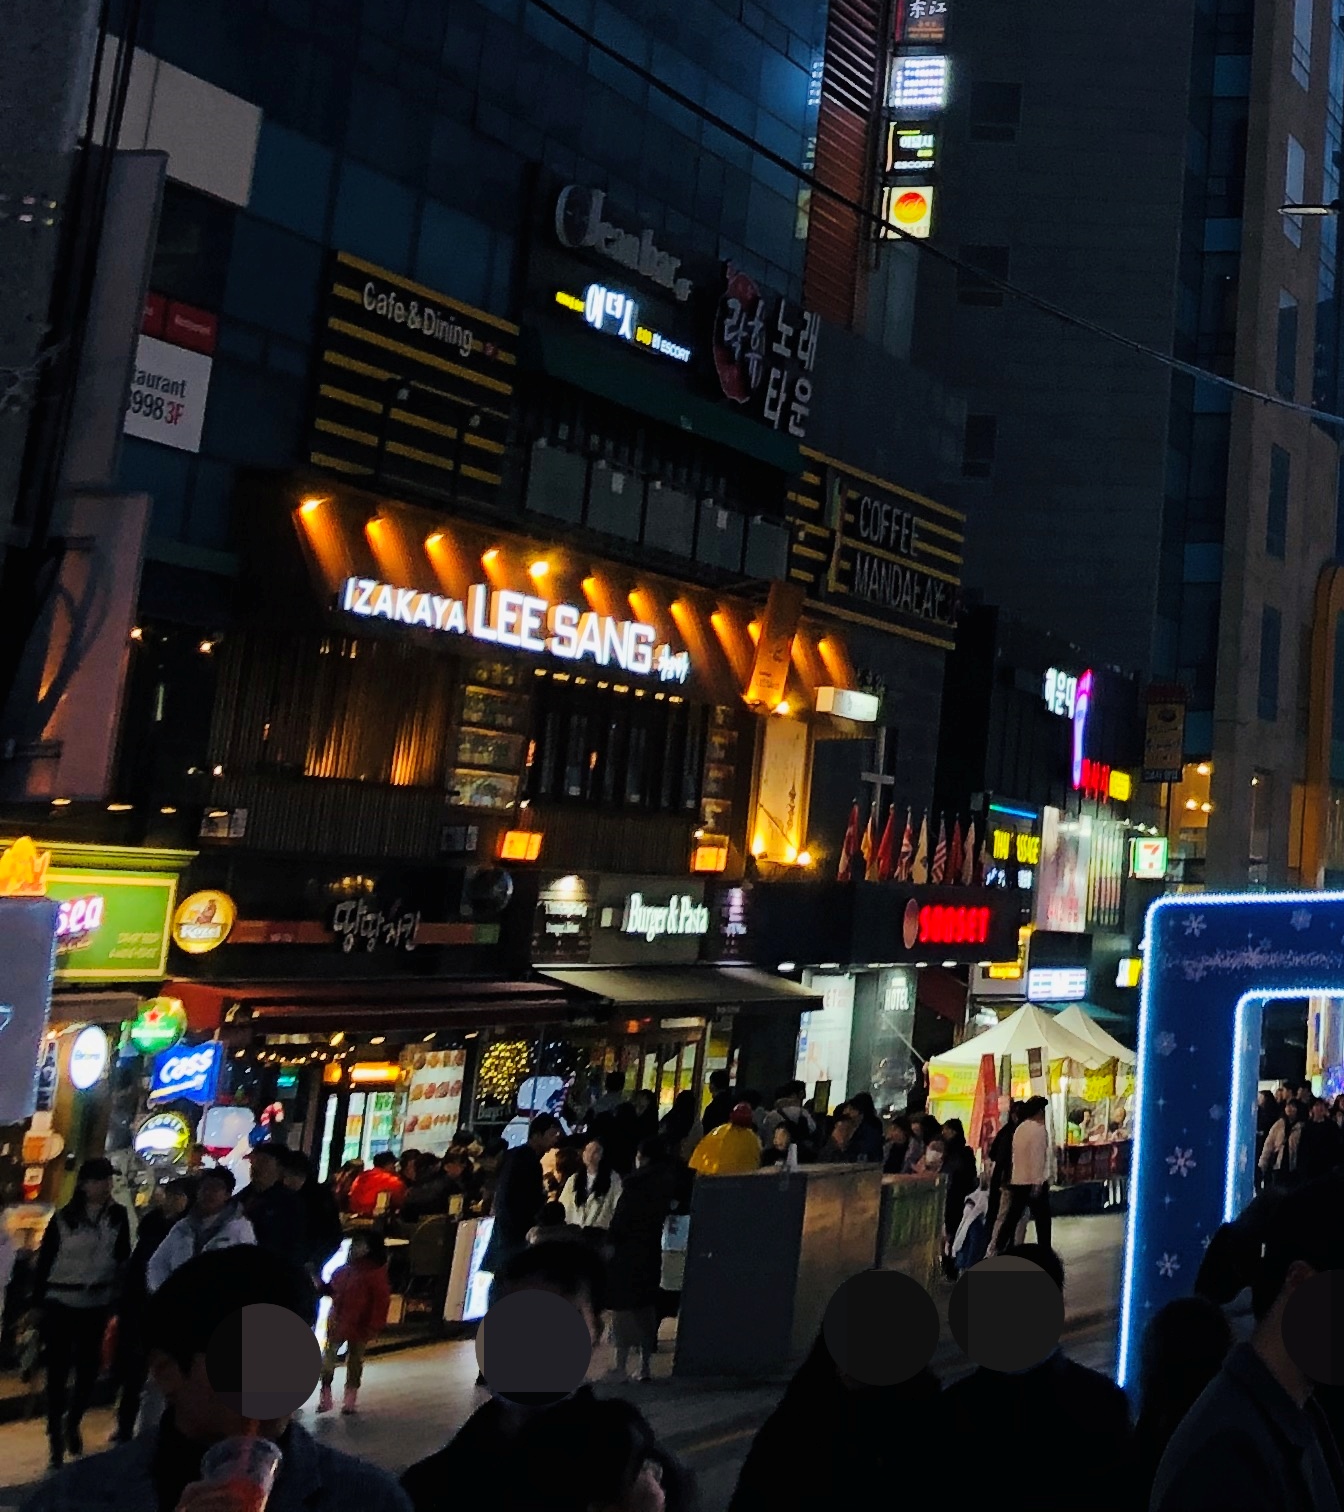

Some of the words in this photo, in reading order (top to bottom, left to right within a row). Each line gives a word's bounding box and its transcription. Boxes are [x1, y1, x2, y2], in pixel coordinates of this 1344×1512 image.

[893, 160, 935, 170] ESCORT
[772, 298, 821, 372] 노래
[127, 388, 165, 421] 998
[132, 369, 188, 399] aurant
[763, 367, 813, 439] 타운
[860, 496, 920, 558] COFFEE
[853, 551, 946, 620] MANDALAY
[343, 577, 466, 635] IZAKAYA
[469, 584, 549, 653] LEE
[549, 604, 657, 675] SANG
[180, 924, 222, 939] Kozel
[884, 987, 910, 1011] HOTEL
[159, 1038, 216, 1084] Cass
